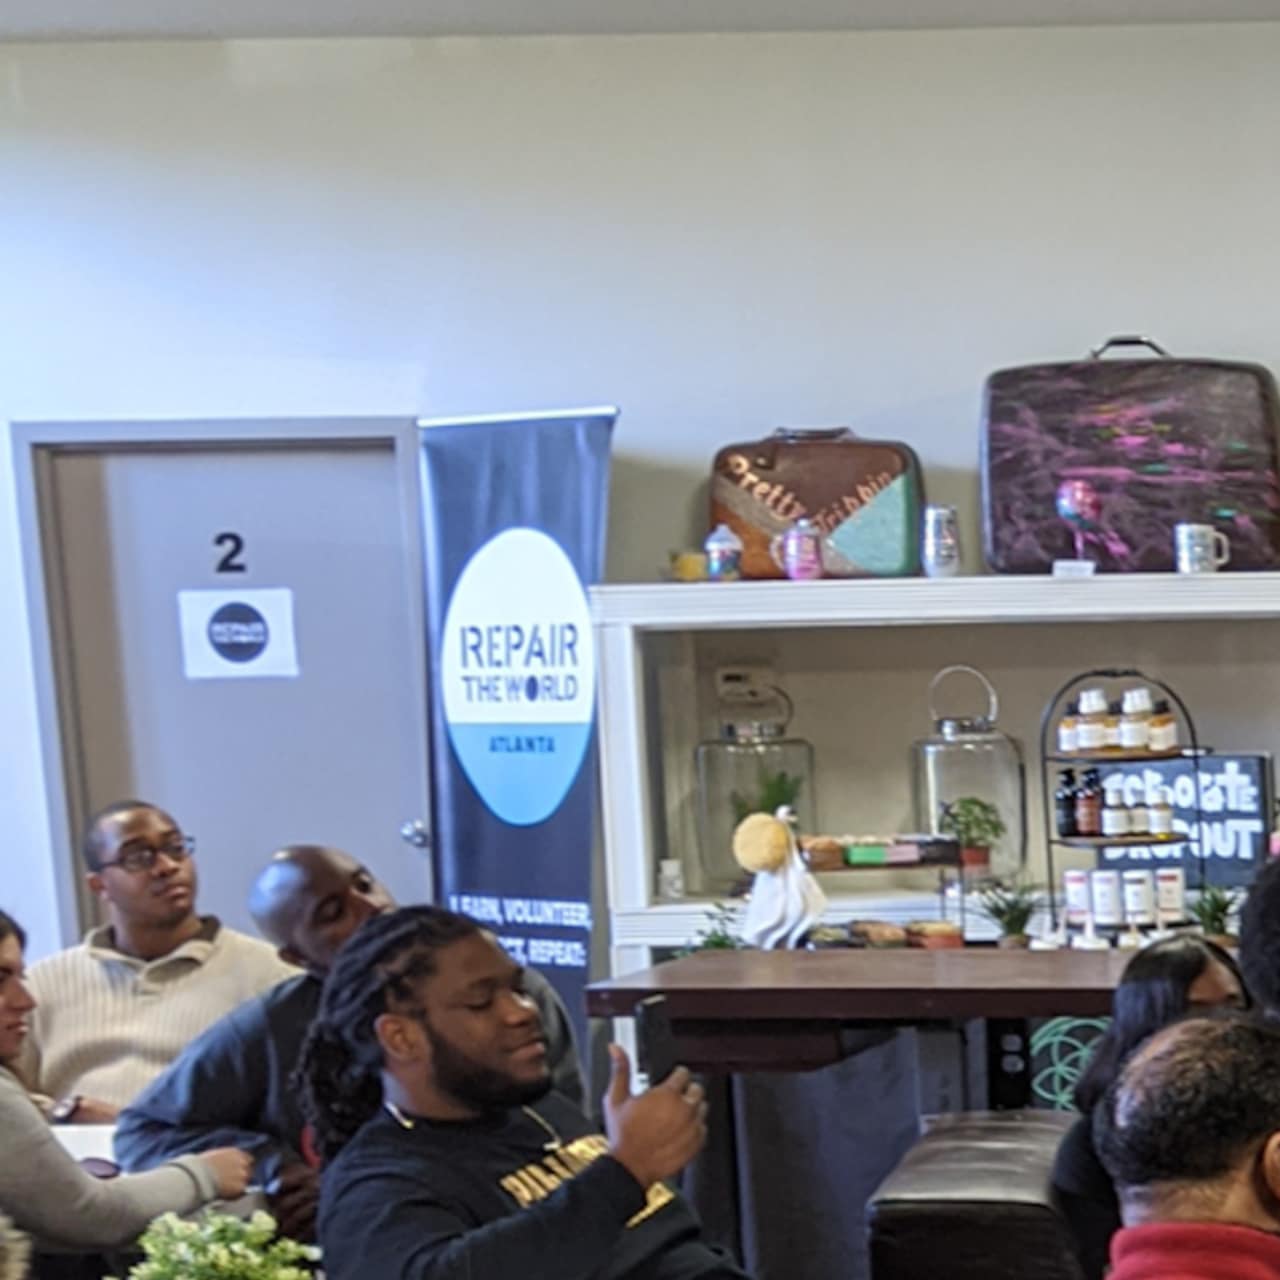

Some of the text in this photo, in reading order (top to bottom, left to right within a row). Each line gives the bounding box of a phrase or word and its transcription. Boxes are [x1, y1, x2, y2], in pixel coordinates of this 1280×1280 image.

[213, 531, 247, 573] 2
[460, 623, 579, 669] REPAIR
[461, 675, 503, 702] THE
[489, 736, 556, 753] ATLANTA
